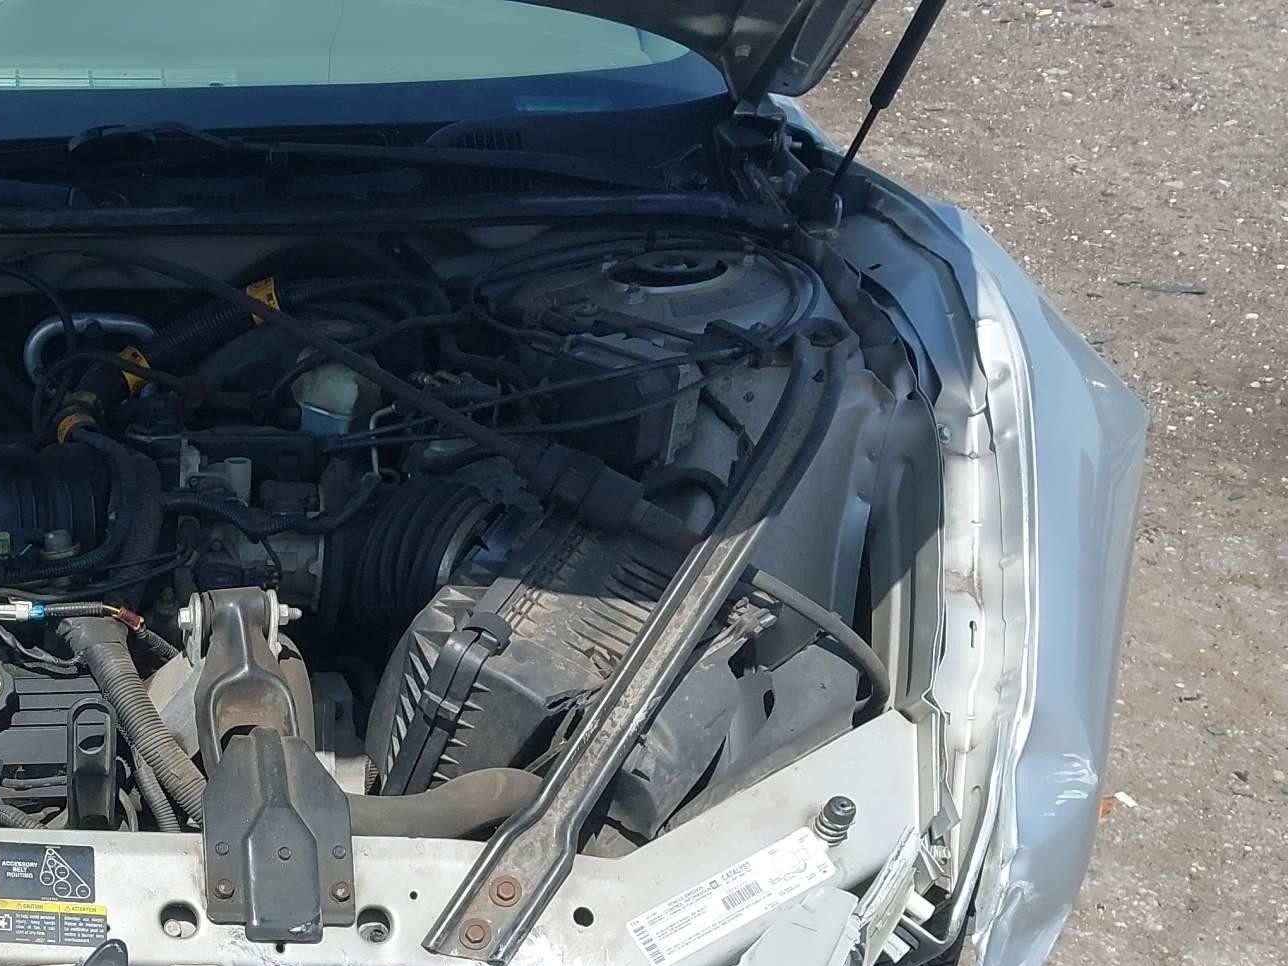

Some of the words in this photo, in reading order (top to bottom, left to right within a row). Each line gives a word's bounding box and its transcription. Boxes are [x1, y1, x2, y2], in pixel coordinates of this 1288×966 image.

[1, 860, 38, 868] ACCESSORY
[6, 871, 33, 879] ROUTING
[721, 861, 752, 881] CATALYST
